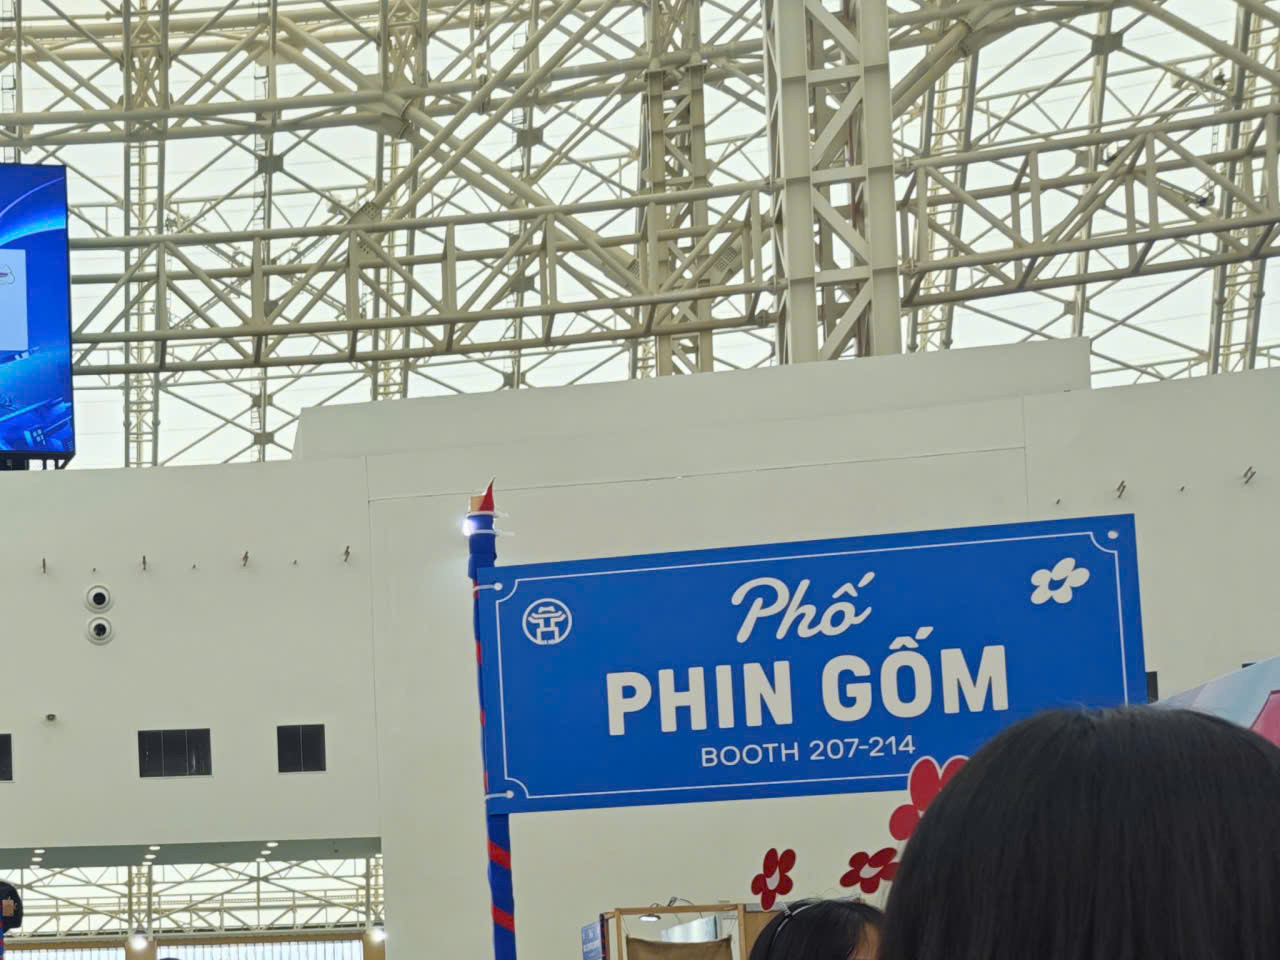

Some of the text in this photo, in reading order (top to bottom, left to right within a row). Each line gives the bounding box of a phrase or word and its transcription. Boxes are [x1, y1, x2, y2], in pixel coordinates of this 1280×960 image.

[731, 571, 876, 643] Phố
[606, 626, 1009, 736] PHIN GỐM
[701, 734, 916, 768] BOOTH 207-214
